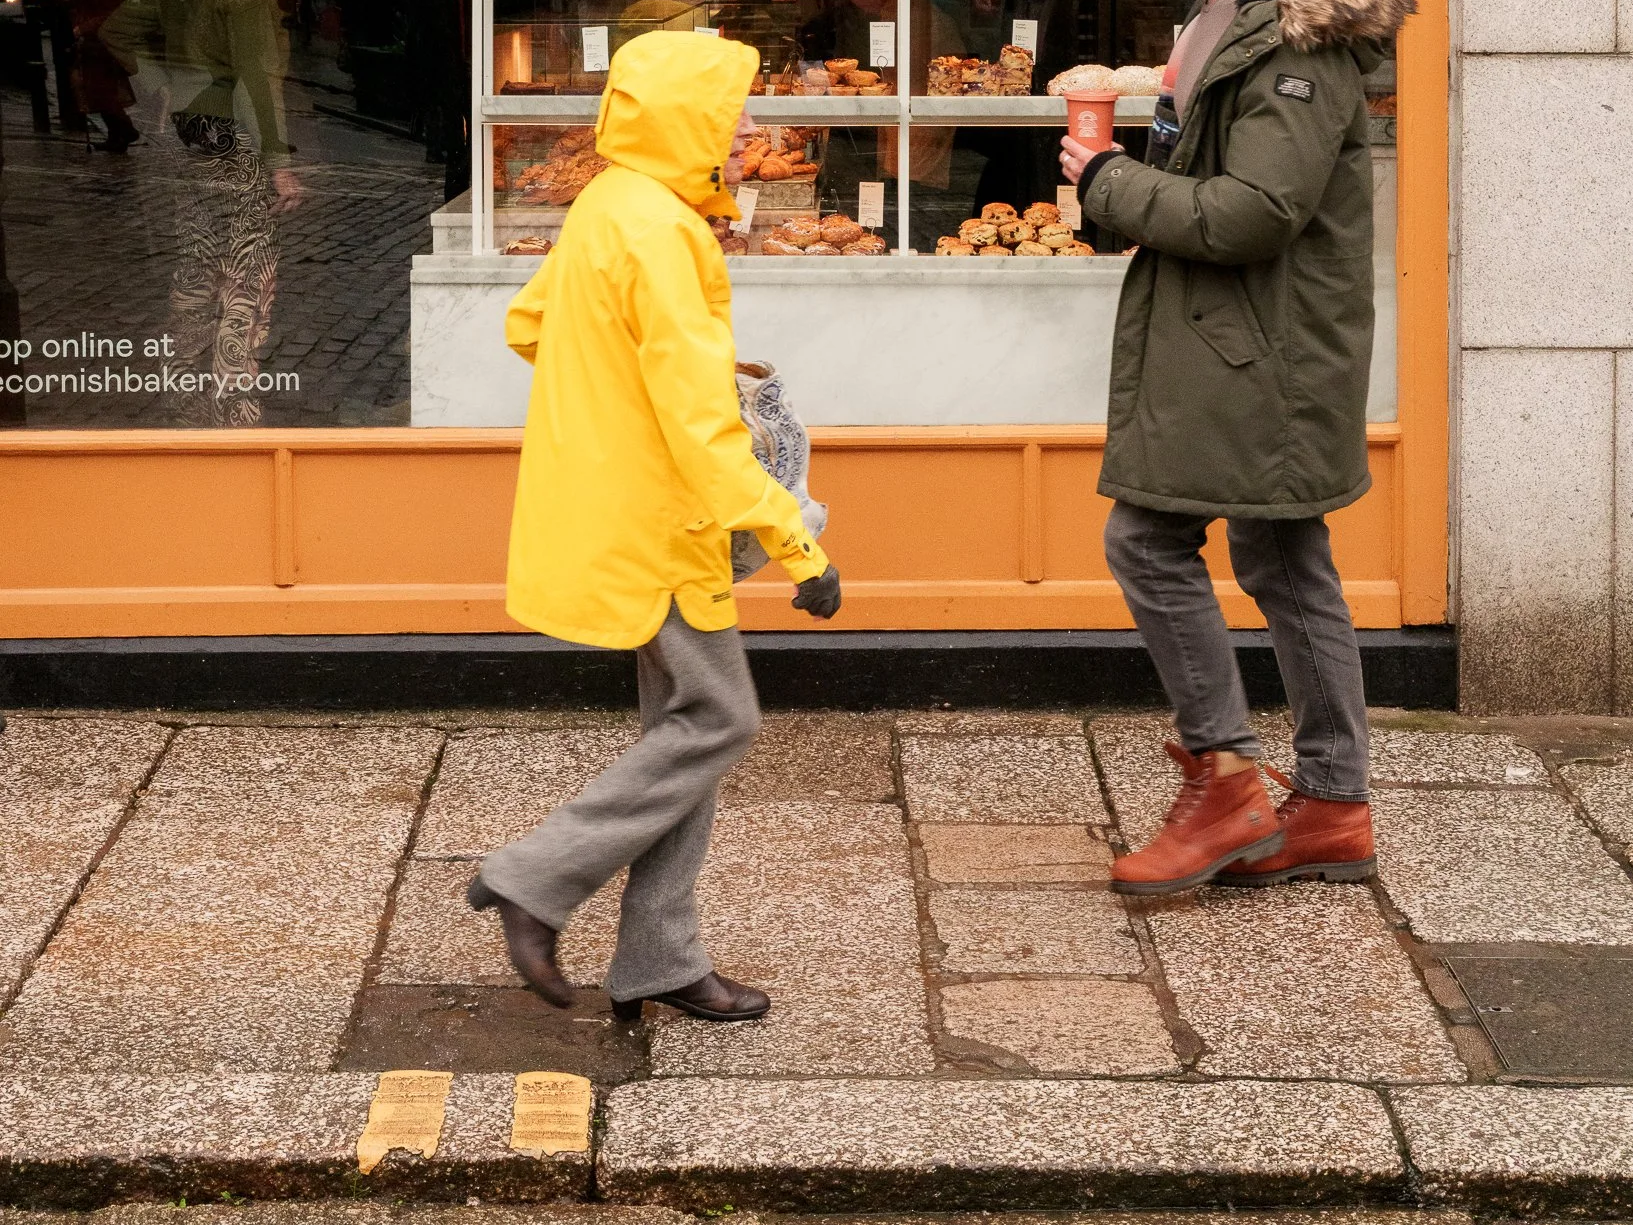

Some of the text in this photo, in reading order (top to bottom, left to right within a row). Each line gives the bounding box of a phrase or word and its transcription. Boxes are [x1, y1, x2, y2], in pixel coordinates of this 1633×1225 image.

[41, 331, 134, 358] online
[143, 333, 176, 358] at
[0, 366, 300, 398] cornishbakery.com
